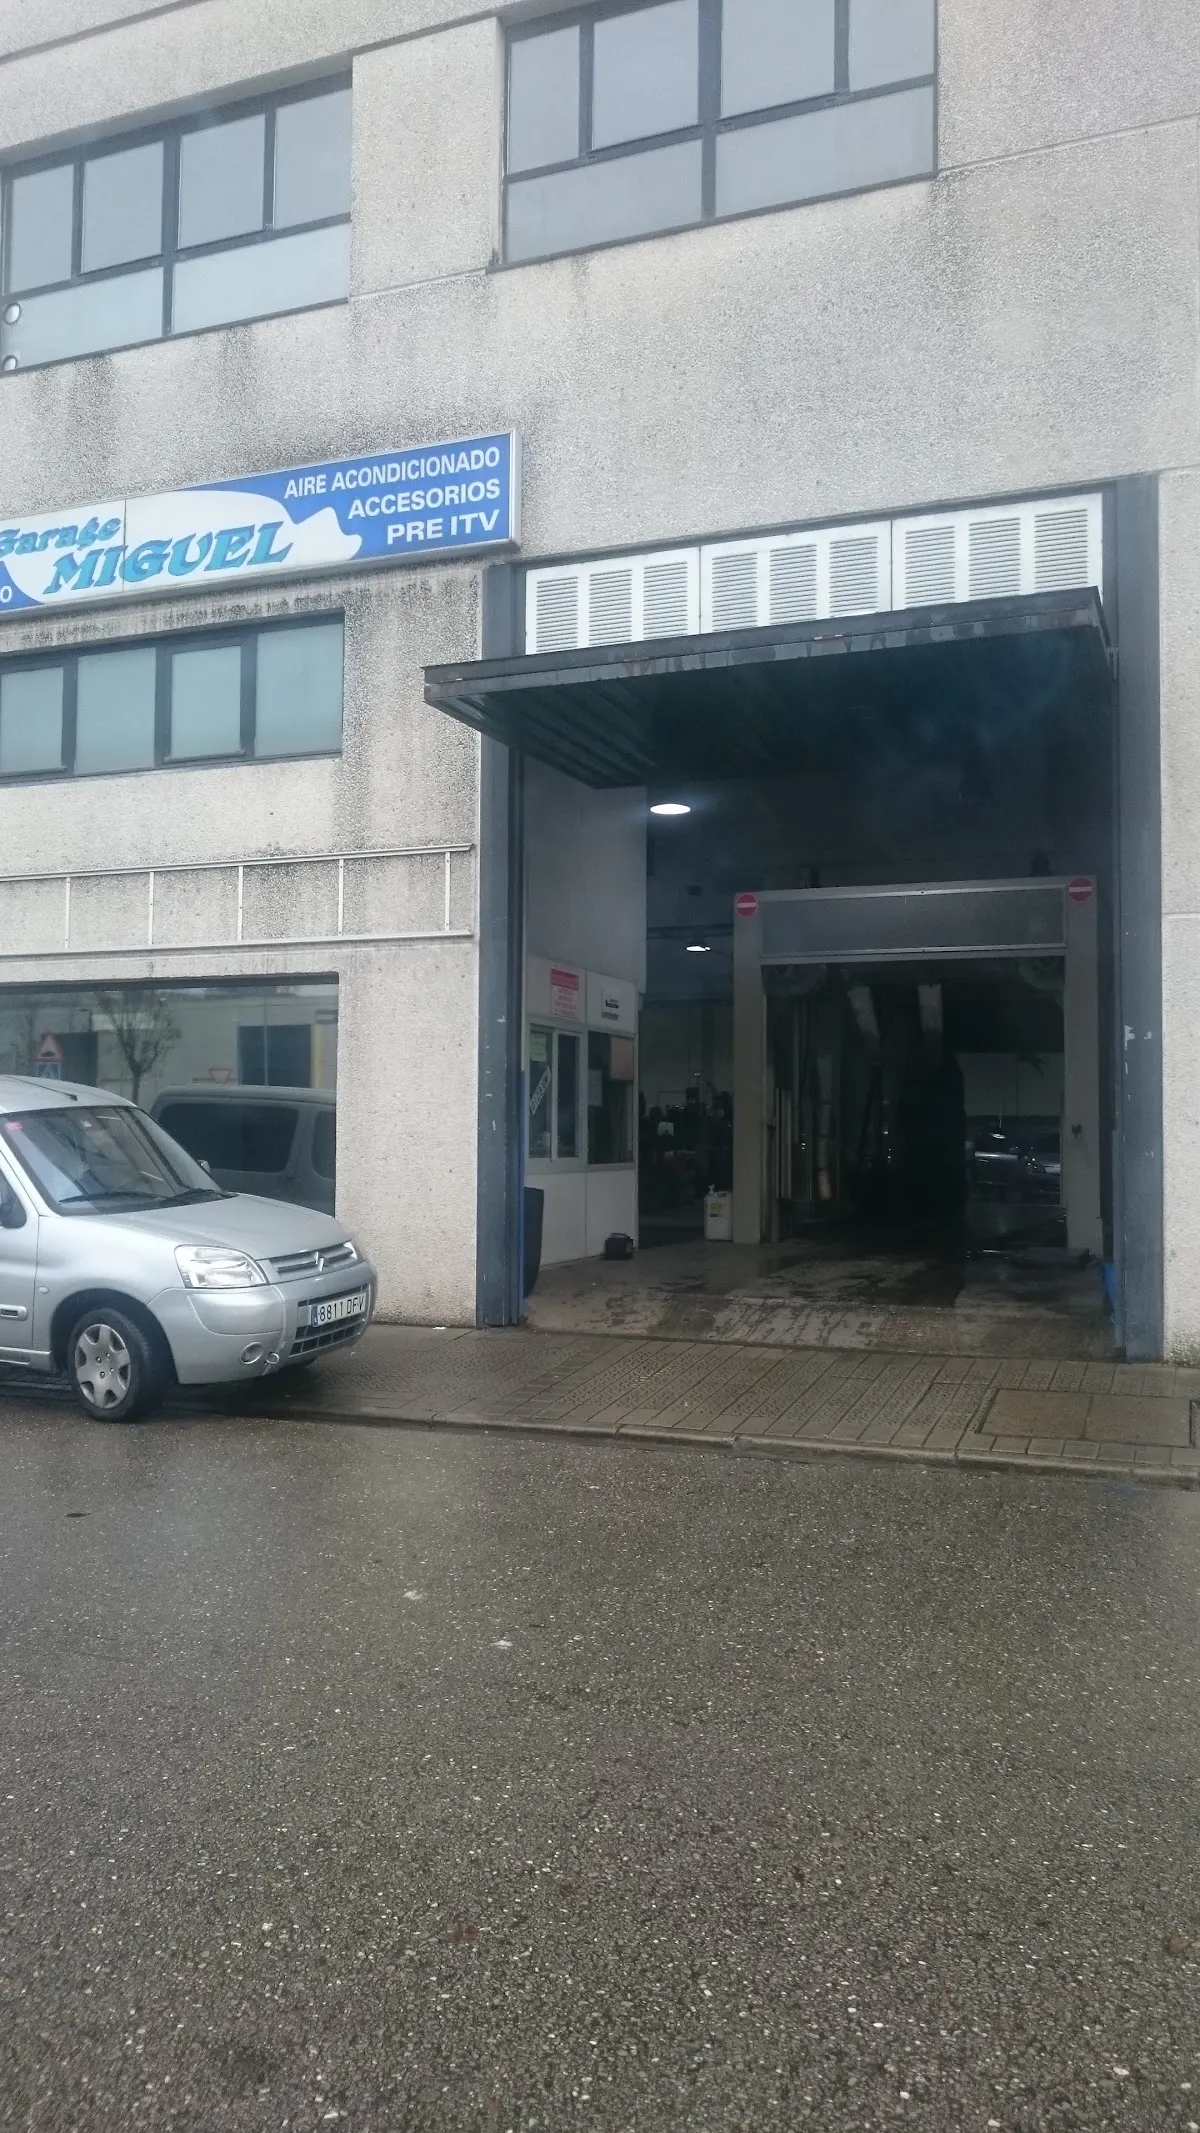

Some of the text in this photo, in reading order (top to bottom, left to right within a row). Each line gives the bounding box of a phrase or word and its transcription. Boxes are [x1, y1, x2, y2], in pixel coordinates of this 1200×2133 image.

[284, 446, 500, 499] AIRE ACONDICIONADO
[347, 479, 500, 519] ACCESORIOS
[0, 516, 121, 558] Garage
[387, 509, 500, 545] PRE ITV
[42, 521, 294, 595] MIGUEL
[319, 1301, 343, 1322] 8811
